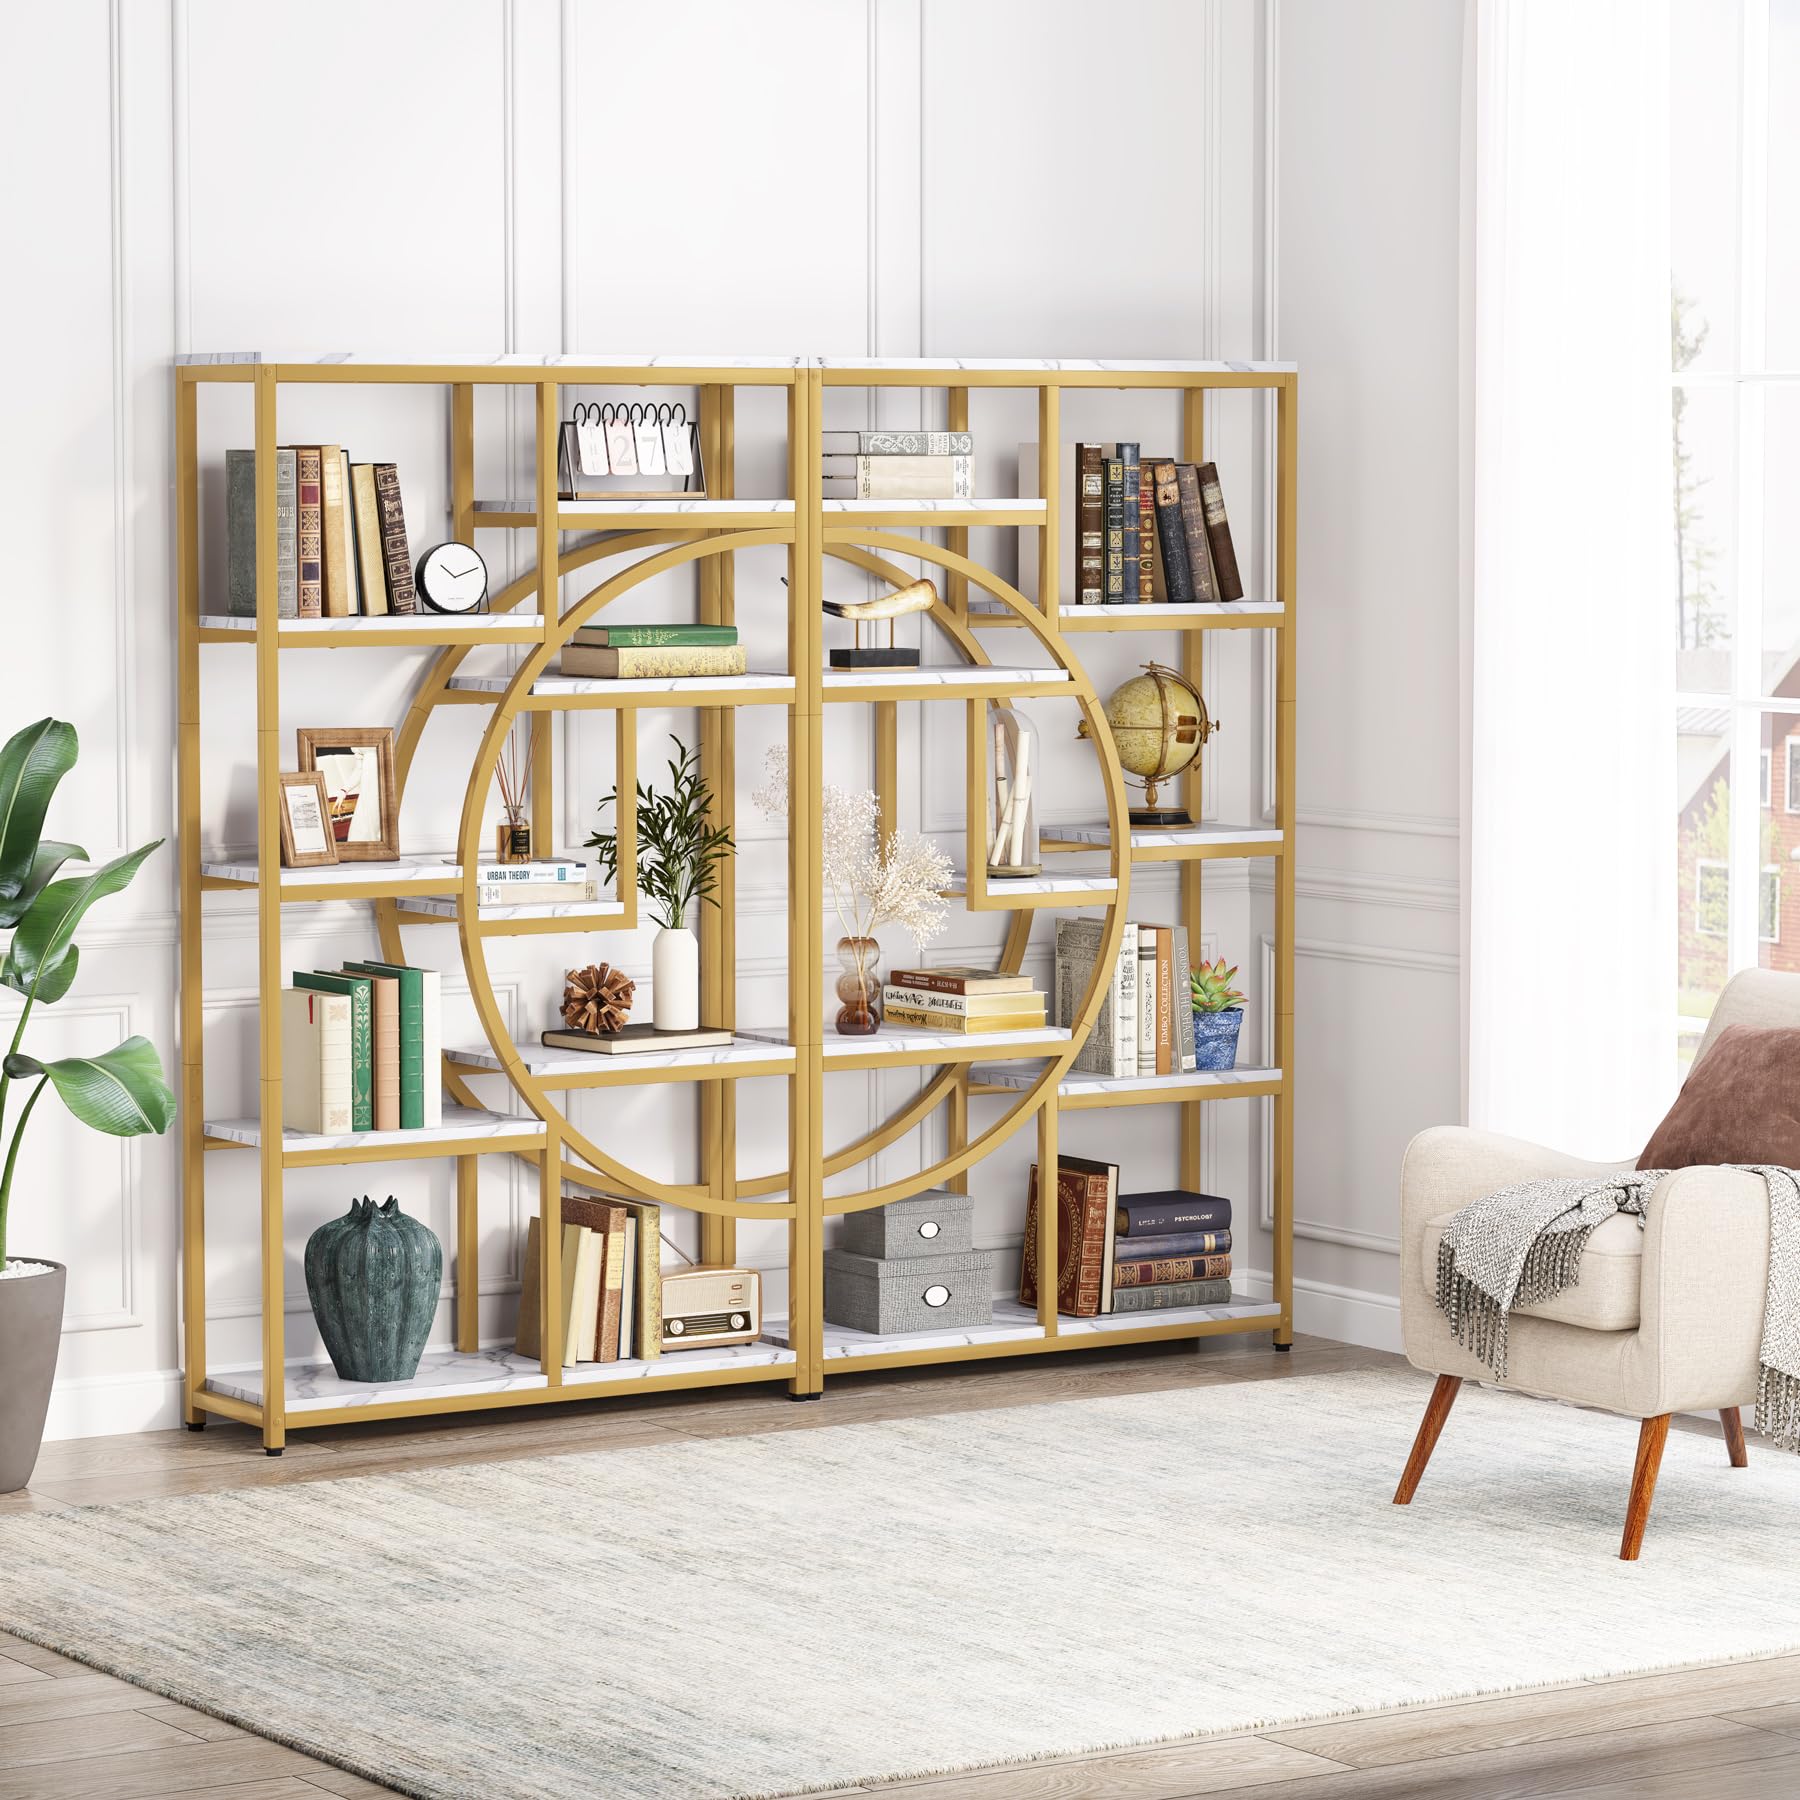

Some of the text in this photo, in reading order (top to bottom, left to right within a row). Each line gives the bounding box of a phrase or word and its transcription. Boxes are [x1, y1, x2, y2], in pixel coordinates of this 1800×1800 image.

[487, 871, 506, 880] URBAN
[509, 870, 530, 880] THEORY
[1178, 944, 1188, 980] YOUNG
[1161, 959, 1169, 1046] JUMBO COLLECTION
[1181, 1012, 1193, 1044] SHACK
[1174, 1214, 1213, 1222] PSYCHOLOGY
